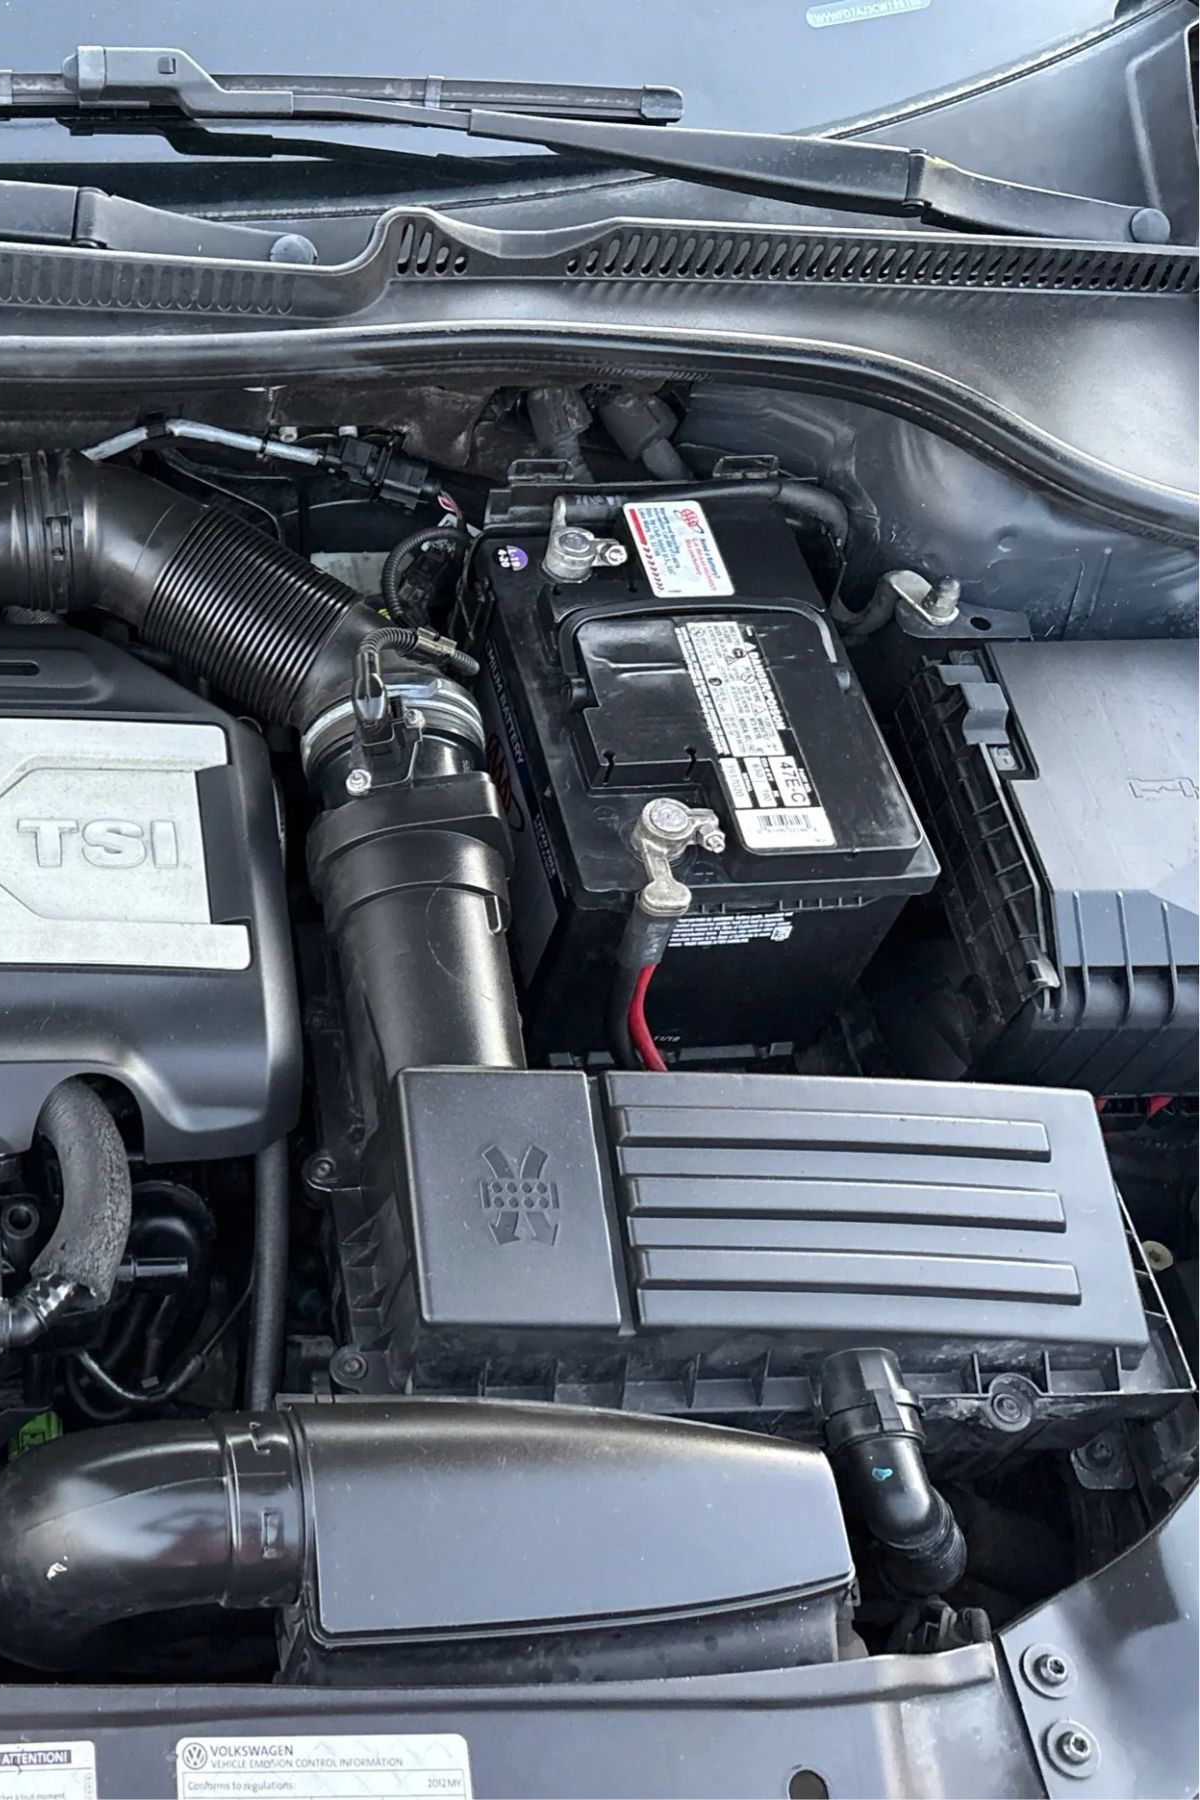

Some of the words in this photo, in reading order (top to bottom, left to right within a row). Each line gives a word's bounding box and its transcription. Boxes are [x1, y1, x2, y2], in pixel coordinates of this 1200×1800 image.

[500, 696, 524, 765] BATTERY
[780, 761, 806, 803] 47E-C
[17, 818, 179, 869] TSI
[209, 1745, 294, 1757] VOLKSWAGEN
[2, 1752, 68, 1766] ATTENTION!
[211, 1760, 246, 1769] VEHICLE
[295, 1759, 337, 1768] CONTROL
[339, 1758, 403, 1768] INFORMATION
[187, 1780, 230, 1790] Conforms
[427, 1778, 446, 1788] 2012
[447, 1778, 462, 1788] MY
